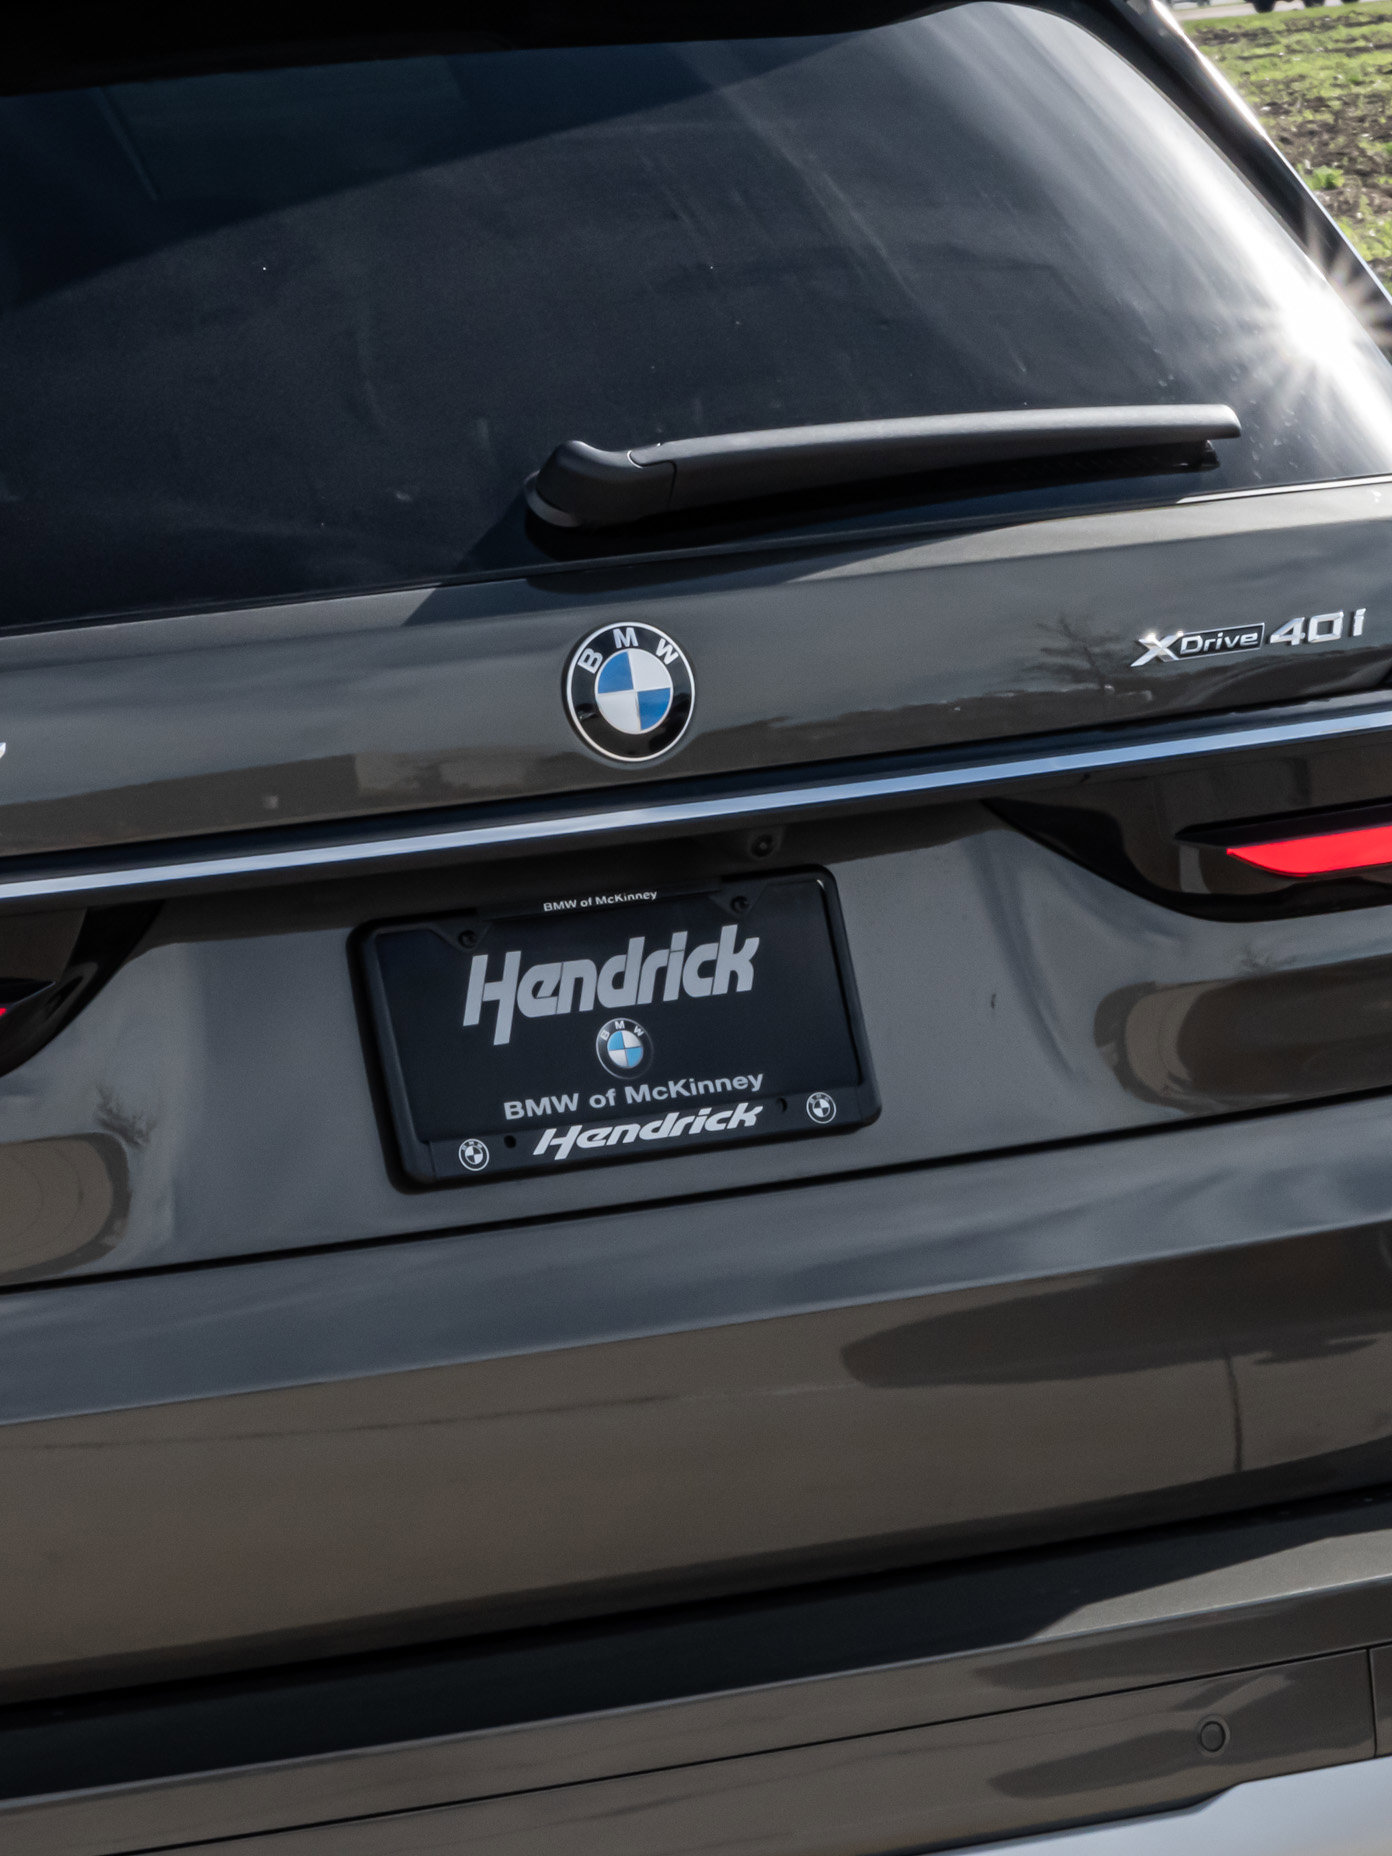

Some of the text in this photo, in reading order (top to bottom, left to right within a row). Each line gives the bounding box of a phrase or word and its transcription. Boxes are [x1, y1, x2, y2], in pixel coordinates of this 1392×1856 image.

[577, 627, 679, 674] BMW
[543, 891, 658, 912] BMW of McKinney
[463, 924, 760, 1045] Hendrick
[600, 1020, 645, 1041] BMW
[504, 1074, 764, 1120] BMW of McKinney
[532, 1102, 764, 1160] Hendrick
